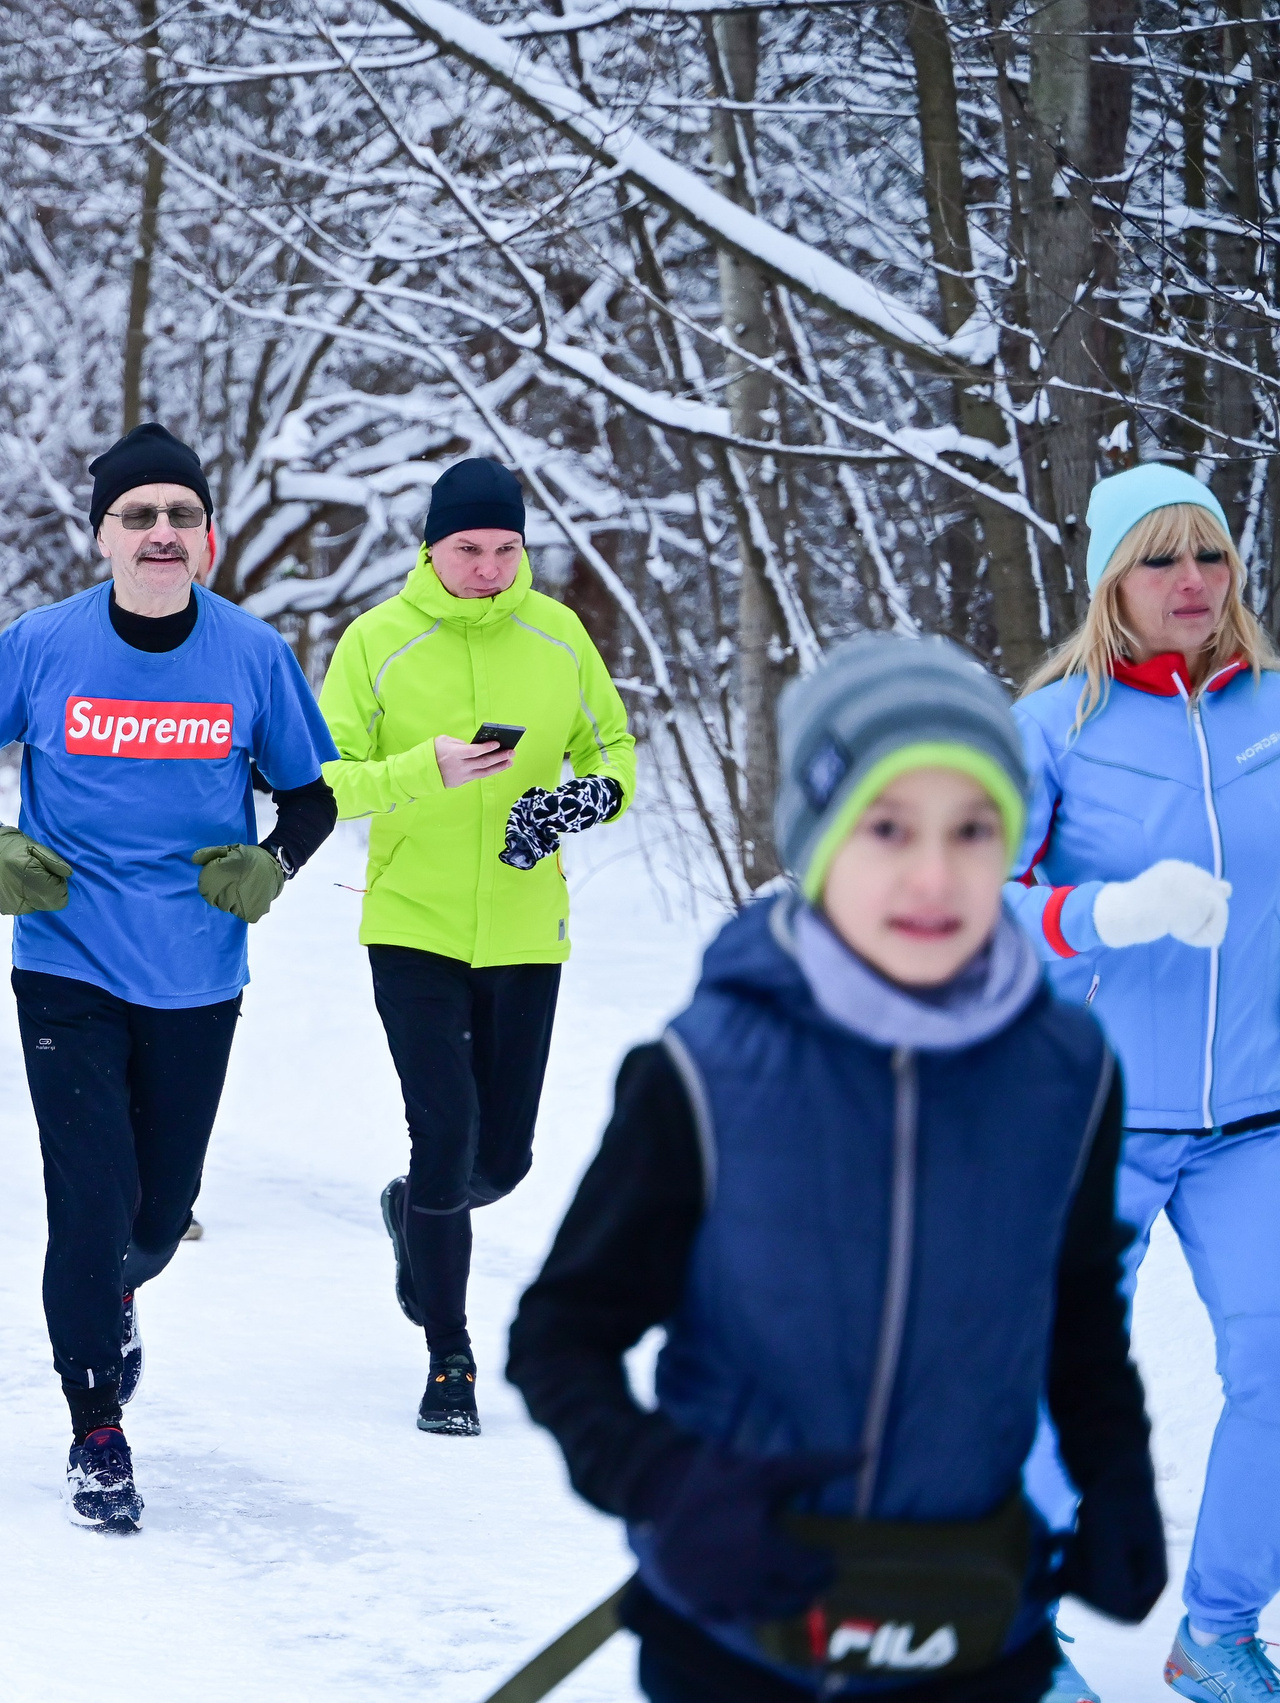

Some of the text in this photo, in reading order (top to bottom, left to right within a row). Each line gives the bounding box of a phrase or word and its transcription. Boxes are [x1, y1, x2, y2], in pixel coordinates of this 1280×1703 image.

[68, 700, 231, 753] Supreme
[1235, 732, 1280, 764] NORDS
[827, 1618, 960, 1671] FILA
